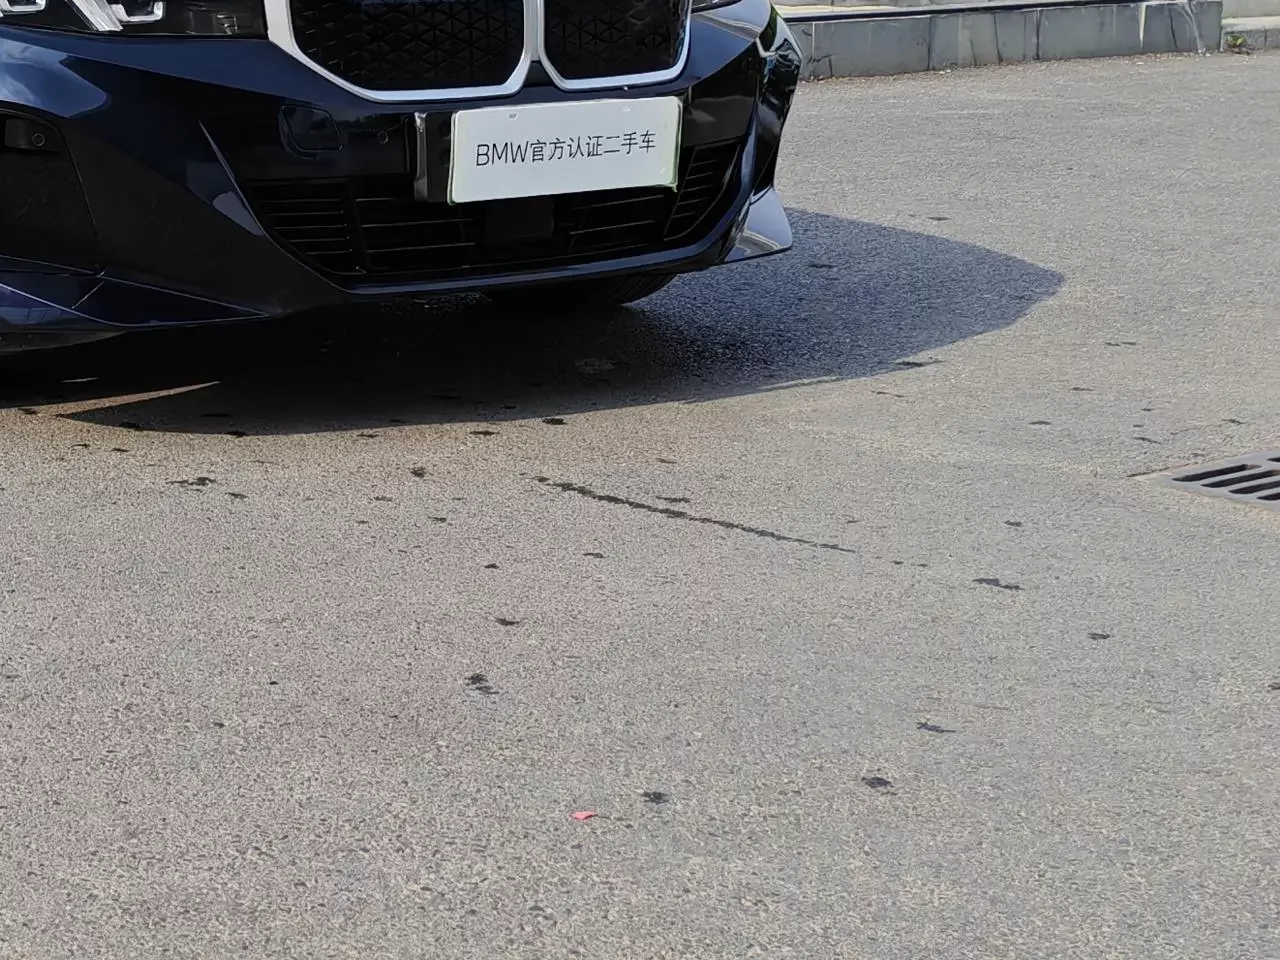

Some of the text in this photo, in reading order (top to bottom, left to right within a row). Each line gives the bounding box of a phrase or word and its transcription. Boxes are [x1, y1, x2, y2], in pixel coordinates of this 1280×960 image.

[475, 129, 657, 167] BMW官方认证二手车
